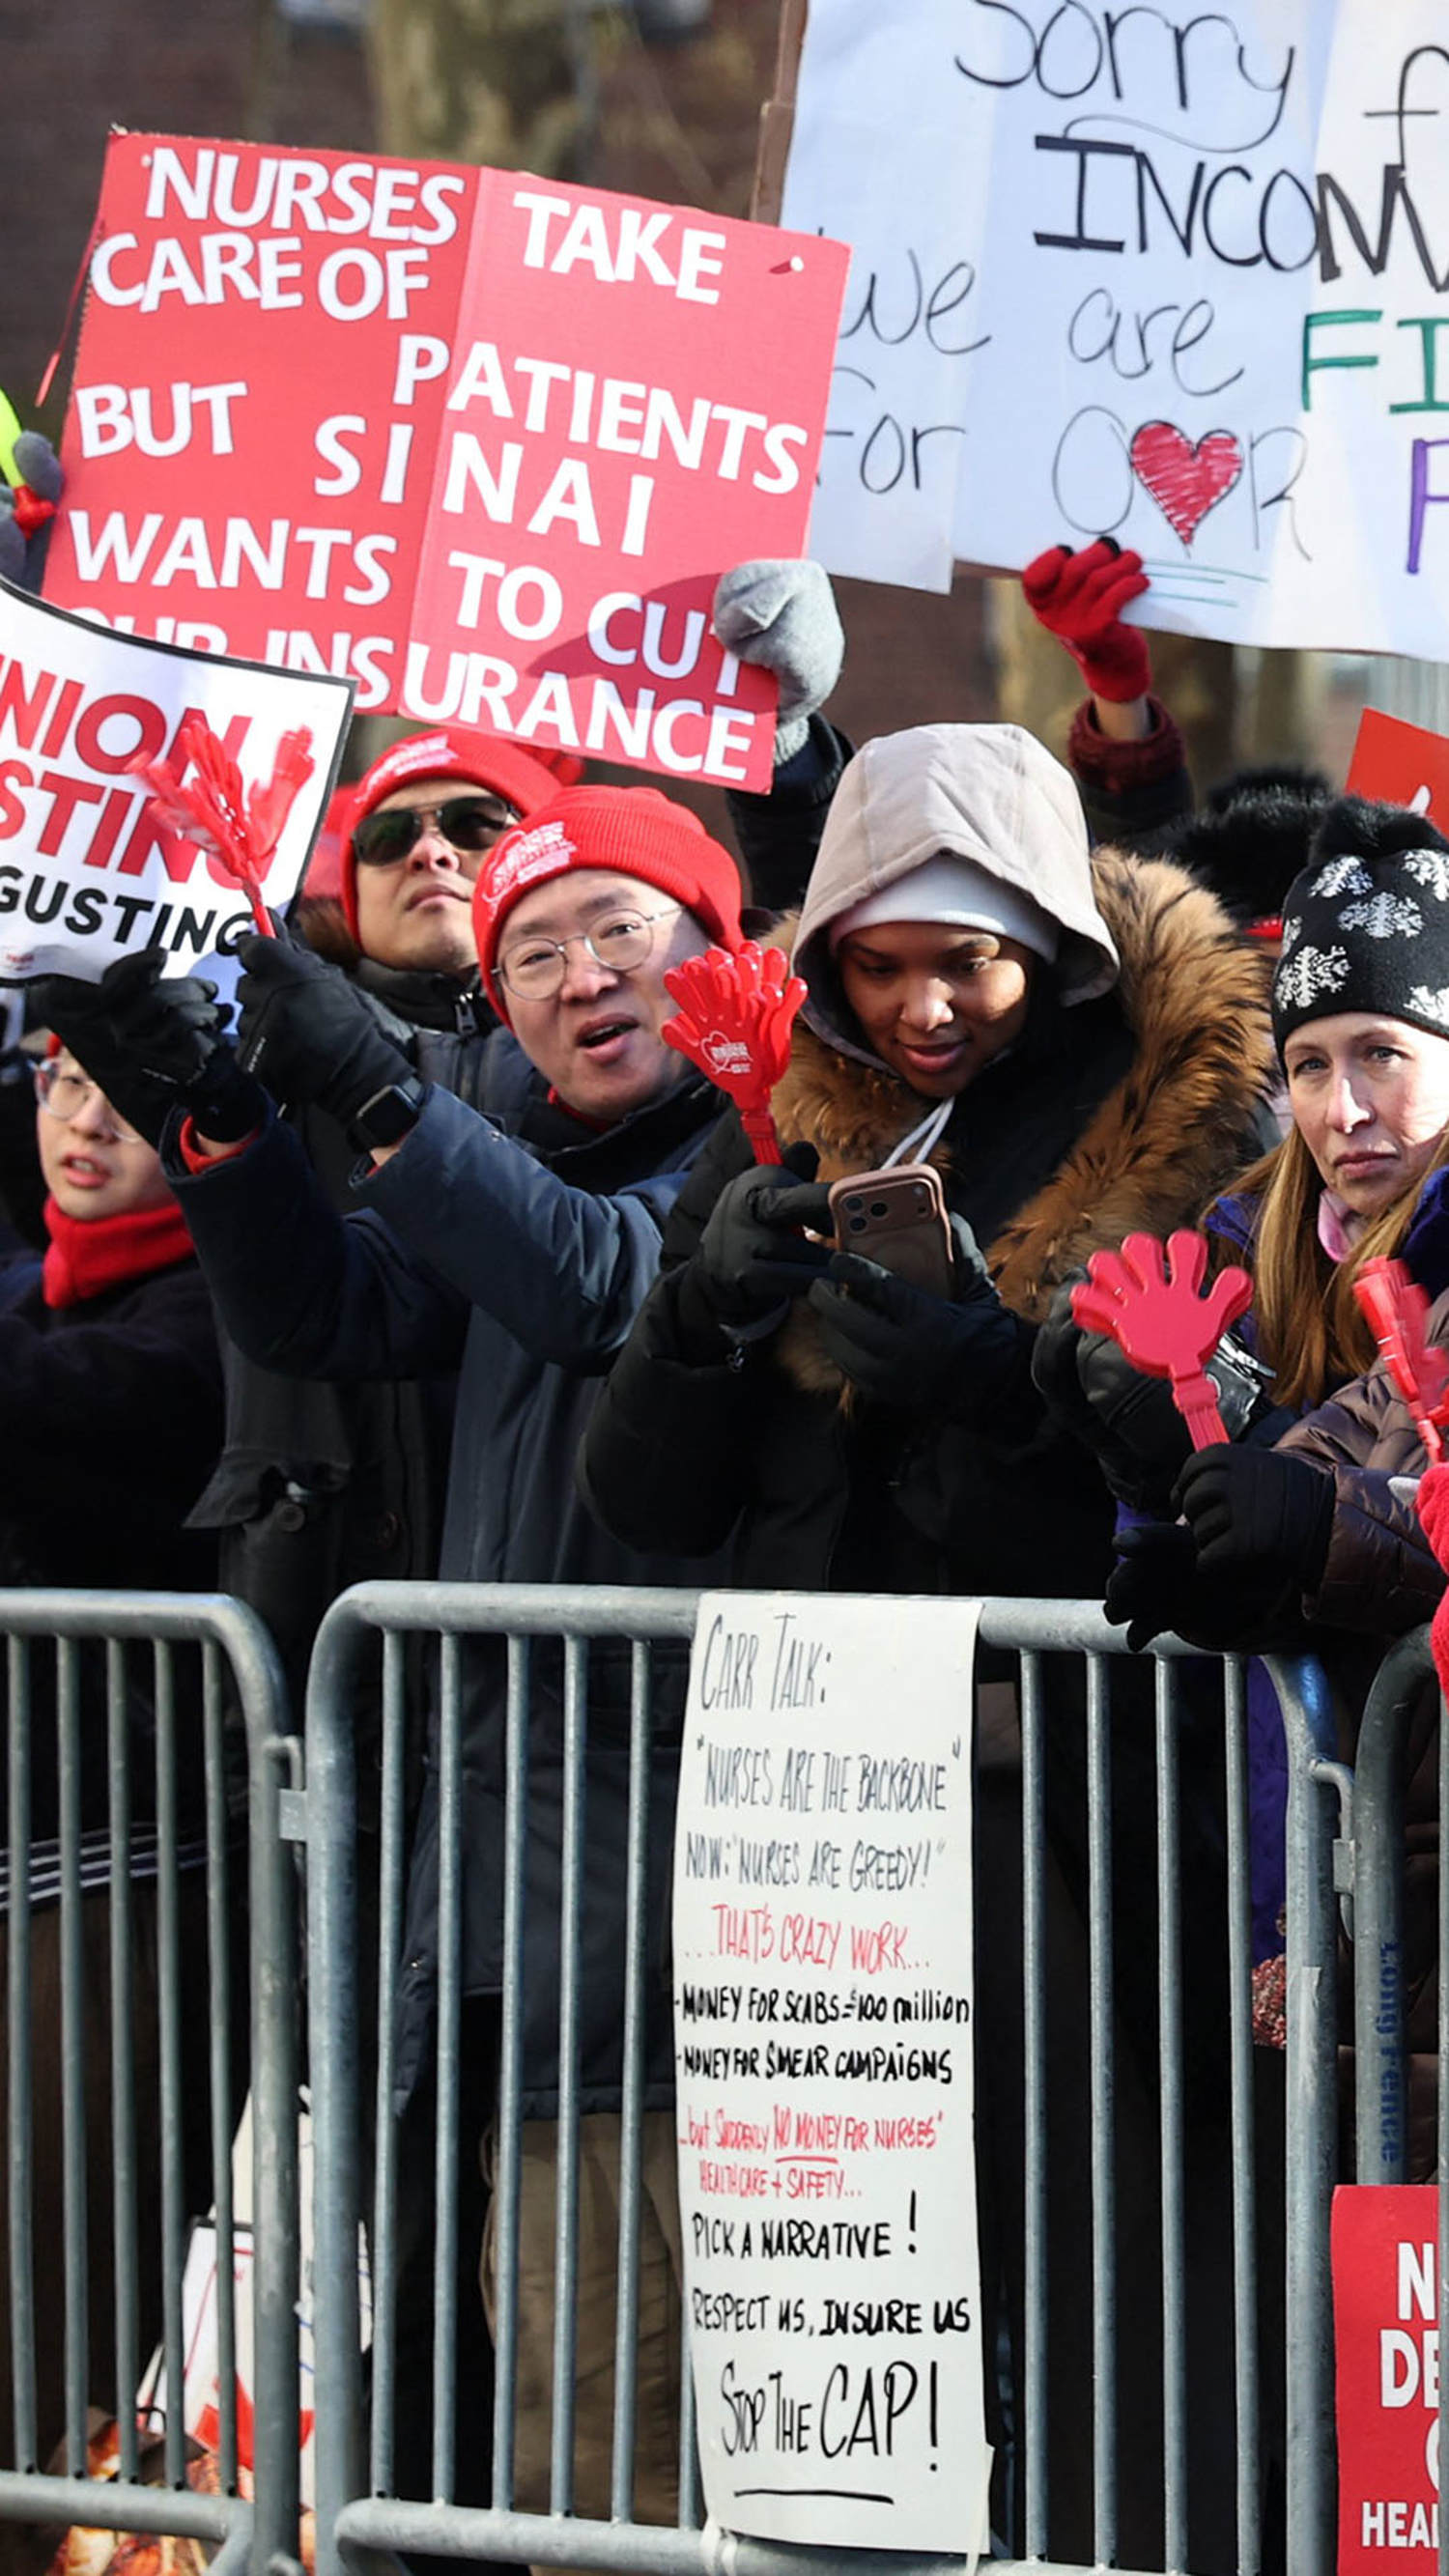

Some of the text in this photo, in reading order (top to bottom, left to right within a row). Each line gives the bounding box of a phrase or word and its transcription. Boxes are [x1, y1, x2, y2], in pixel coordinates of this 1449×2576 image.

[145, 147, 727, 305] NURSES TAKE
[88, 232, 430, 322] CARE OF
[1068, 289, 1245, 396] are
[75, 382, 249, 459] BUT
[392, 334, 809, 495] PATIENTS
[70, 510, 397, 607] WANTS
[447, 551, 562, 640] TO
[0, 653, 253, 787] NION
[779, 1747, 815, 1813] ARE
[821, 1752, 850, 1813] THE
[807, 1841, 841, 1888] ARE
[780, 1913, 841, 1970] CRAZY
[748, 1988, 781, 2023] FOR
[893, 1989, 970, 2024] million
[733, 2046, 761, 2079] FOR
[773, 2104, 792, 2152] NO
[795, 2111, 843, 2151] MONEY
[844, 2116, 870, 2152] FOR
[692, 2212, 734, 2259] PICK
[741, 2220, 753, 2259] A
[760, 2219, 892, 2260] NARRATIVE
[692, 2287, 771, 2334] RESPECT
[819, 2299, 923, 2336] INSURE
[932, 2298, 971, 2335] US
